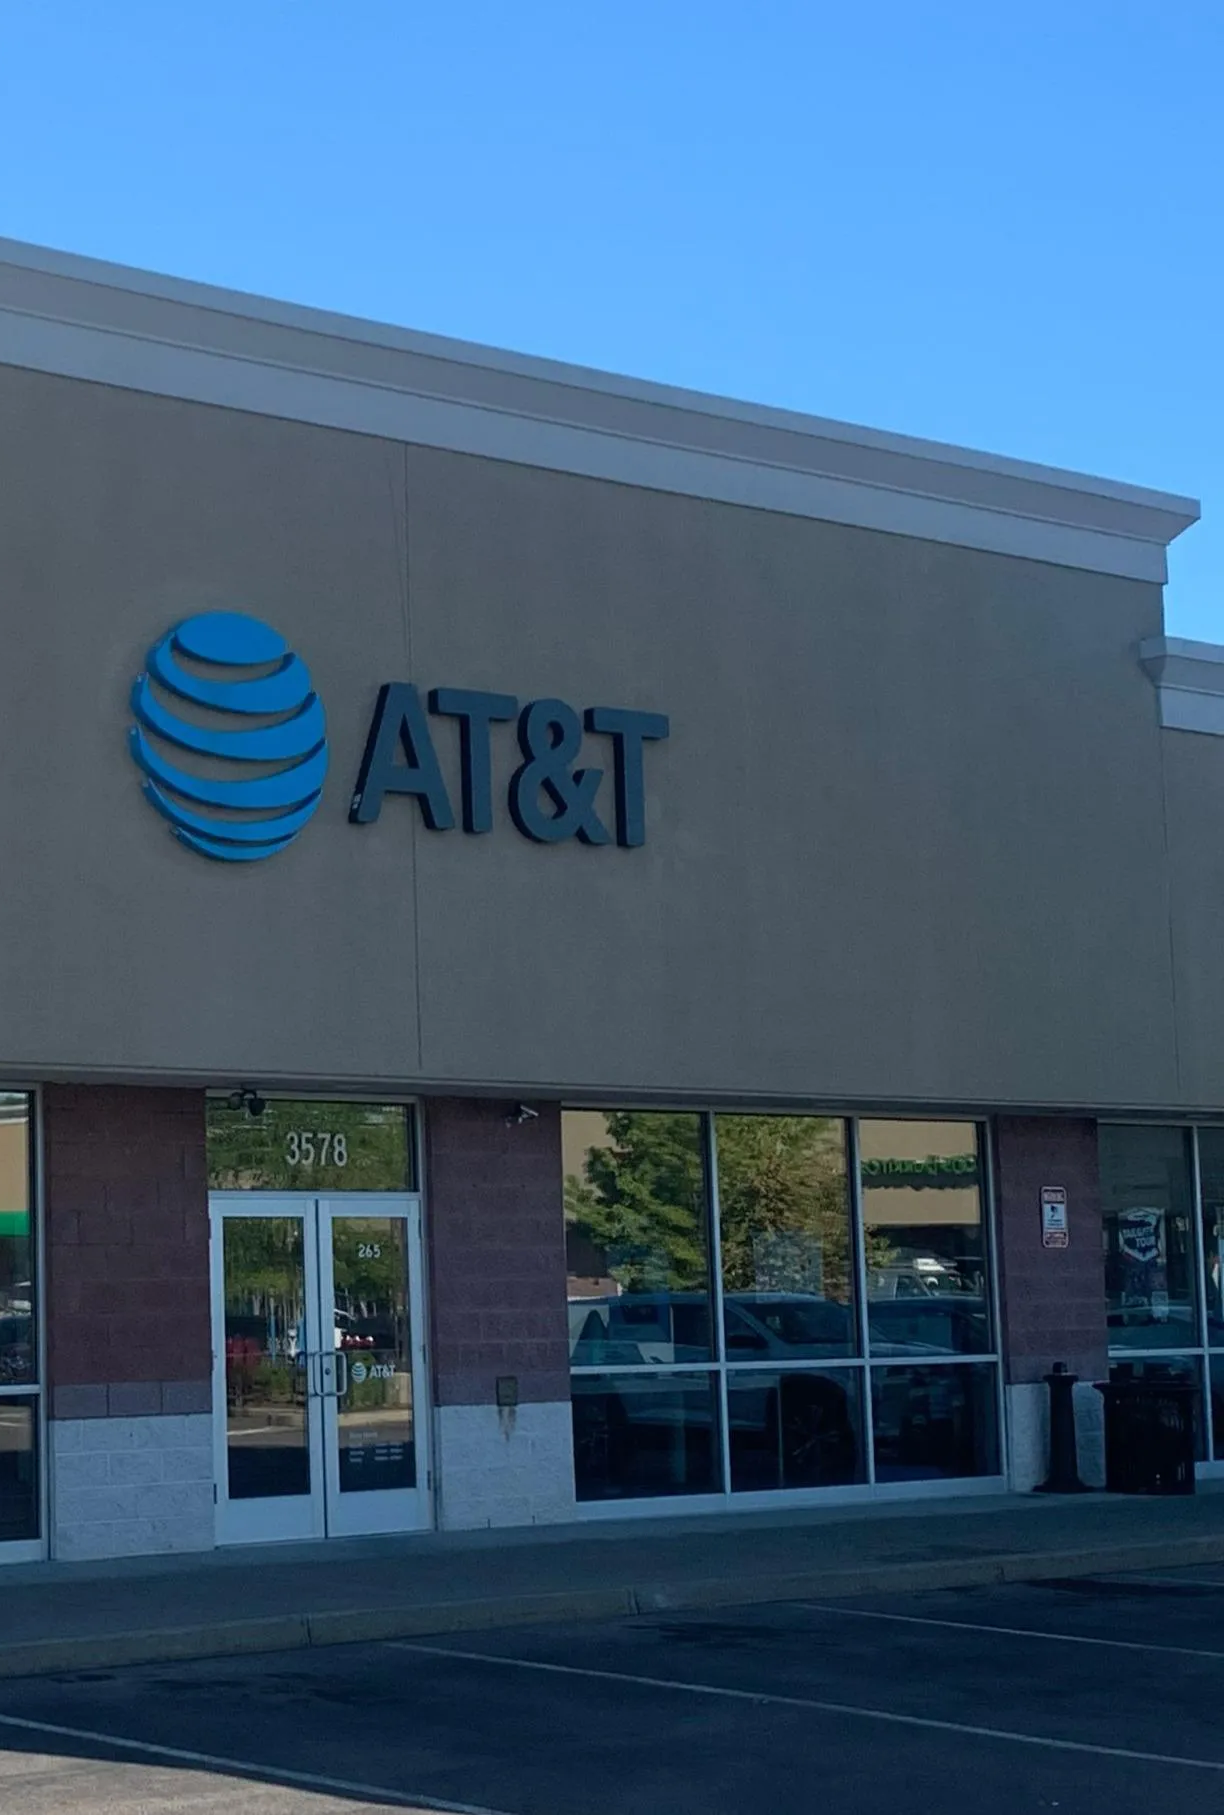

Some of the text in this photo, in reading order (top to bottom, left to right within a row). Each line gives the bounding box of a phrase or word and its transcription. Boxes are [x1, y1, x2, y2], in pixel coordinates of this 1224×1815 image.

[348, 681, 670, 848] AT&T
[286, 1131, 347, 1167] 3578
[358, 1243, 381, 1258] 265
[369, 1364, 395, 1378] AT&T
